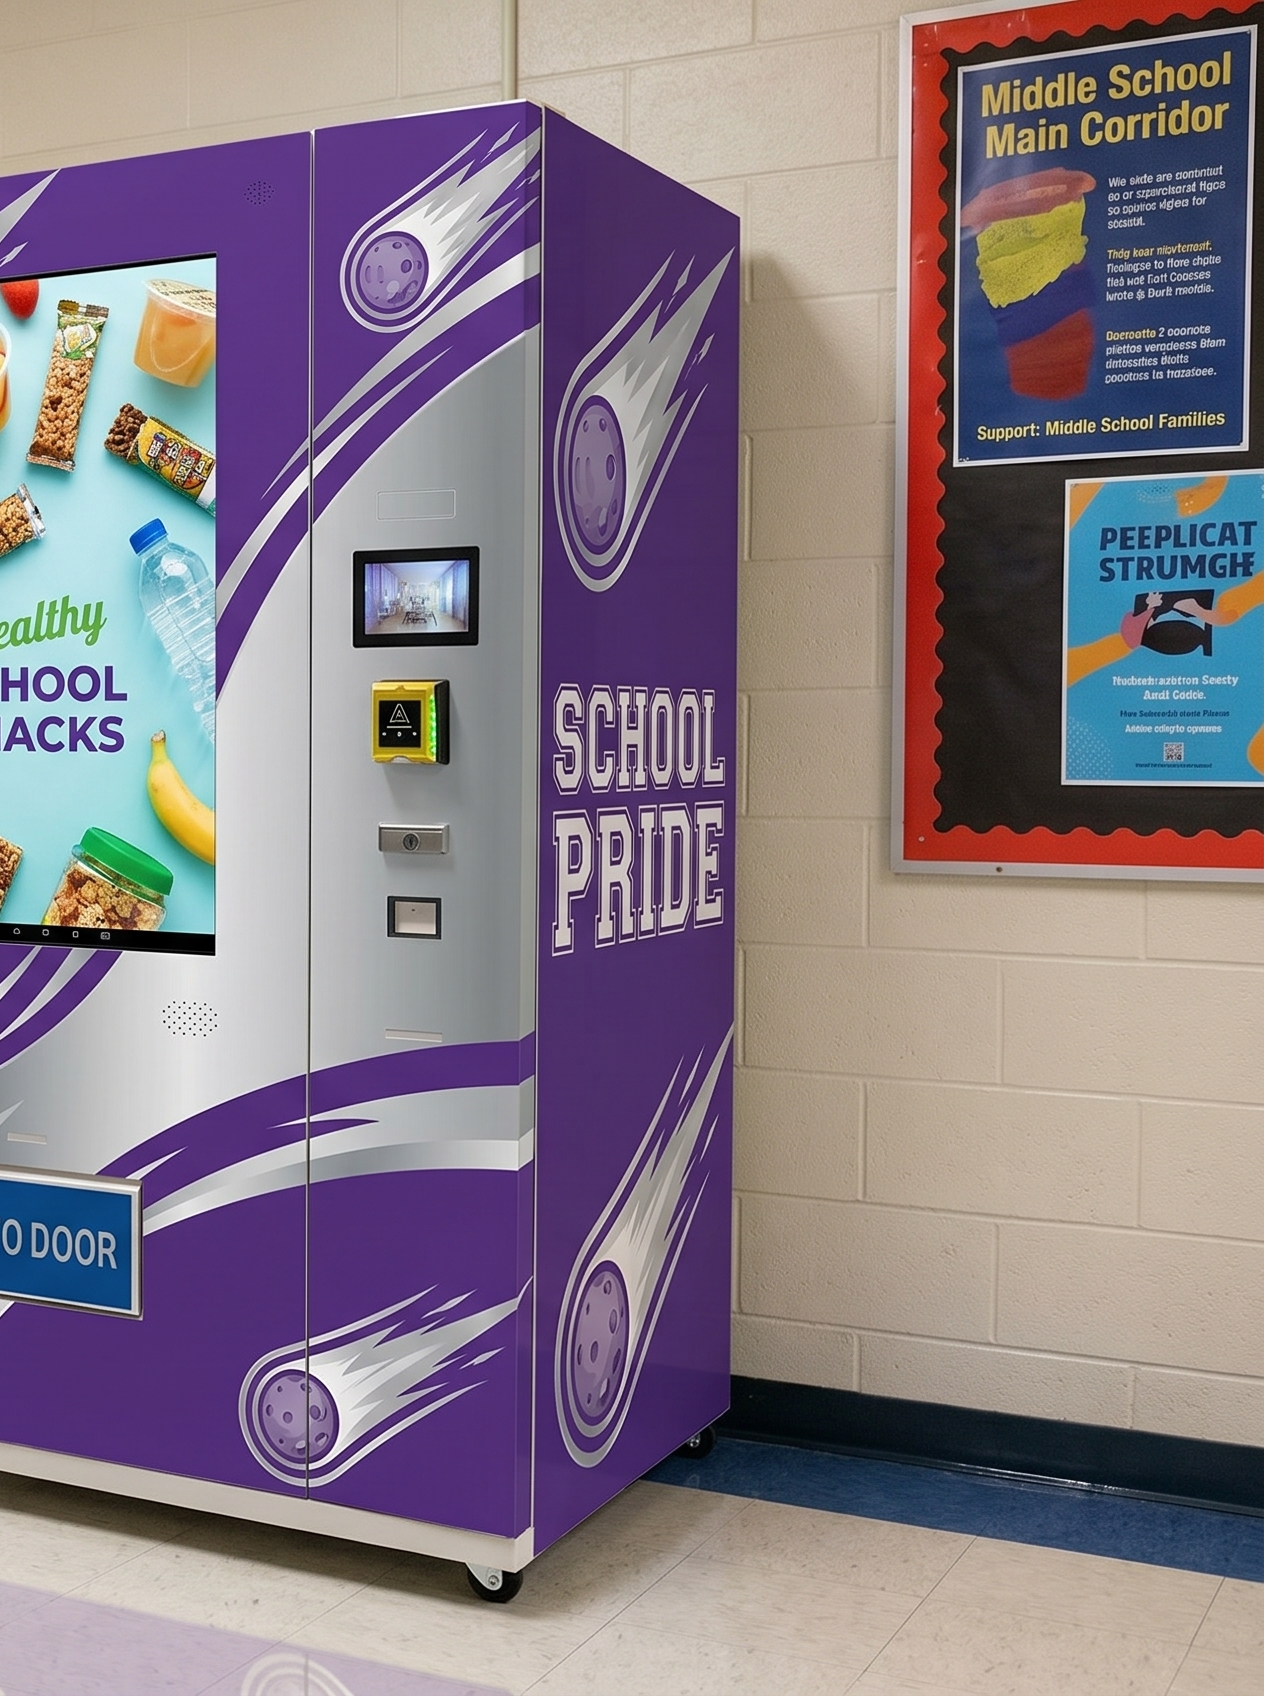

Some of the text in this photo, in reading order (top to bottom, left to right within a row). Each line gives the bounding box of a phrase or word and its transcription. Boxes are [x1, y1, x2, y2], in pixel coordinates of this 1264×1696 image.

[981, 50, 1232, 117] Middle School
[986, 99, 1230, 159] Main Corridor
[1154, 259, 1165, 270] to
[1158, 326, 1166, 338] 2
[976, 411, 1226, 442] Support: Middle School Families
[1099, 520, 1258, 551] PEEPLICAT
[553, 682, 726, 796] SCHOOL
[552, 800, 725, 957] PRIDE
[30, 1221, 118, 1270] DOOR
